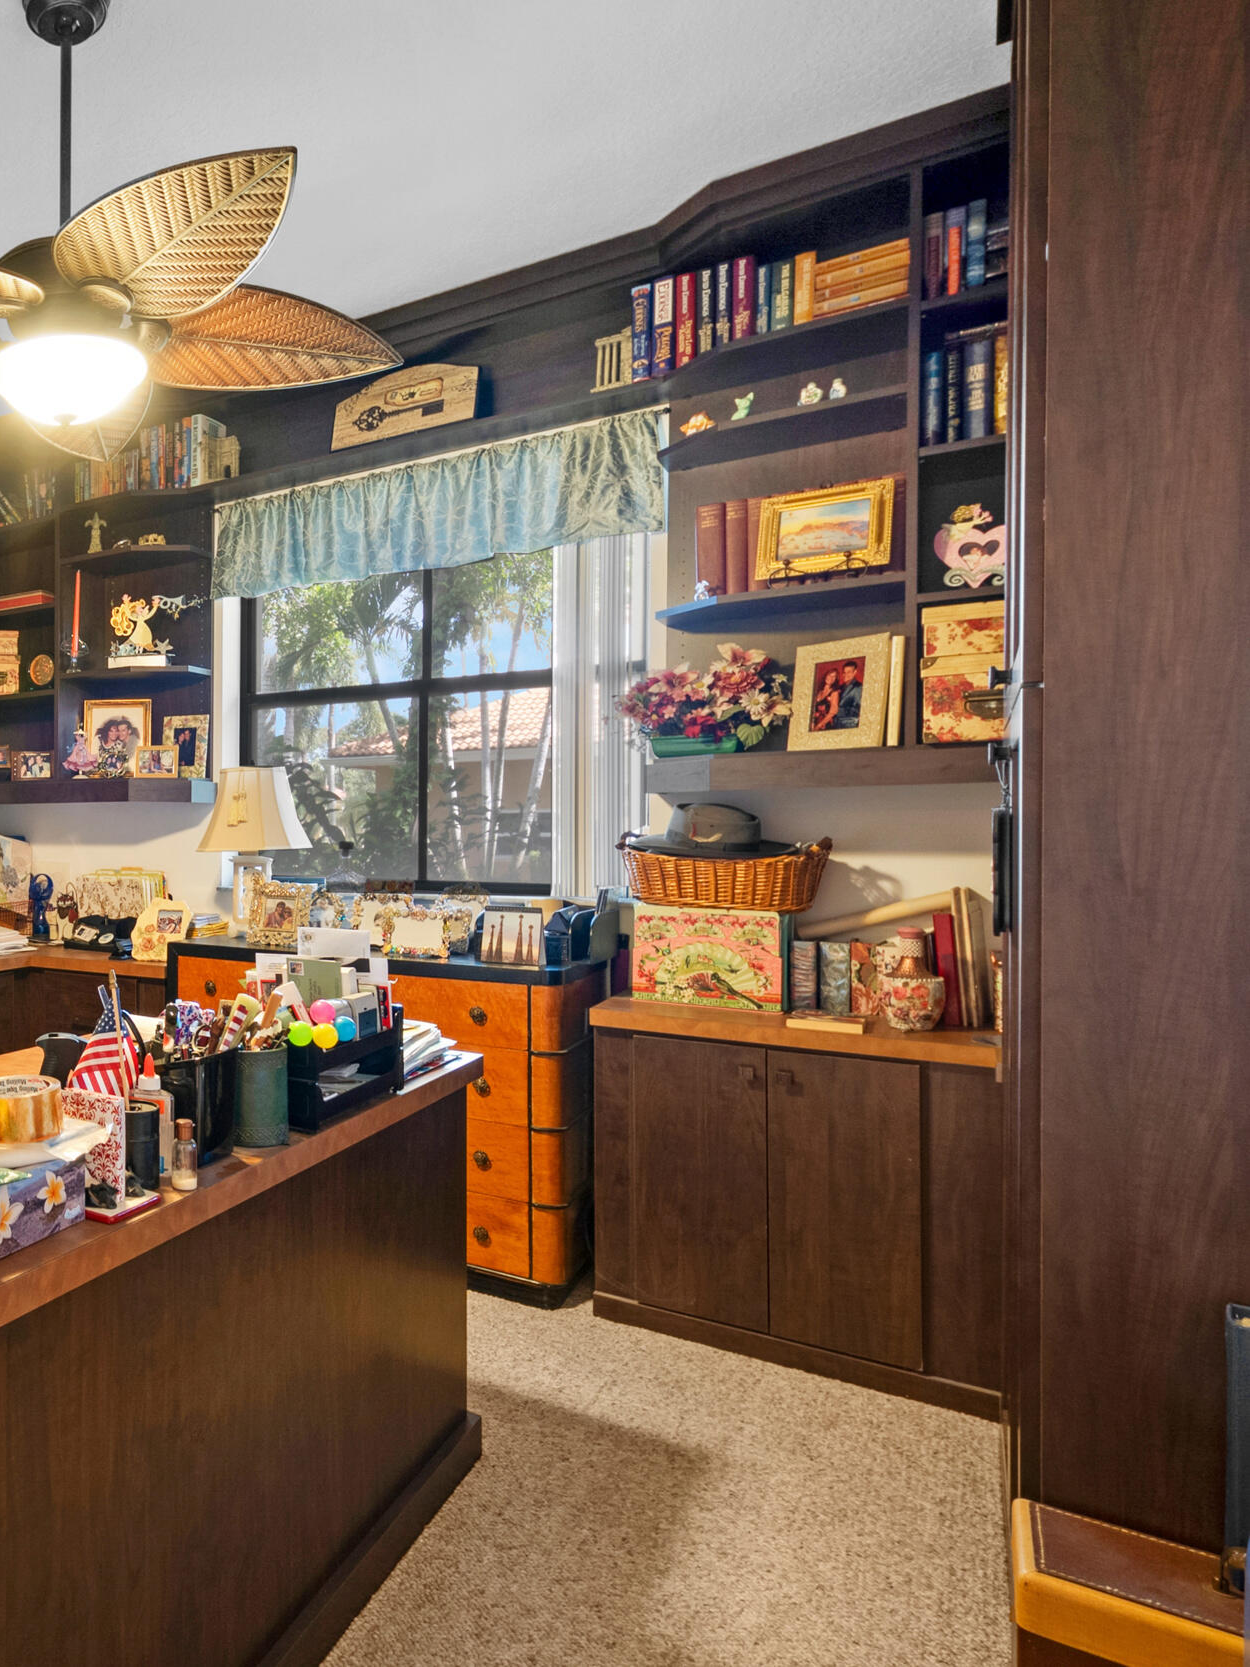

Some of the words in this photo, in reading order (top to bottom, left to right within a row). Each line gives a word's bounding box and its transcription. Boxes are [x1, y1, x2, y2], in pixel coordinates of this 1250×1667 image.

[702, 269, 711, 289] DAVID
[719, 263, 728, 282] DAVID
[781, 264, 790, 278] THE
[719, 282, 728, 310] EDDINGS
[739, 275, 747, 299] EDDINGS
[657, 282, 670, 322] EDDINGS
[681, 291, 690, 314] EDDINGS
[702, 289, 711, 317] EDDINGS
[634, 298, 648, 334] EDDINGS
[655, 326, 672, 364] POLGARA
